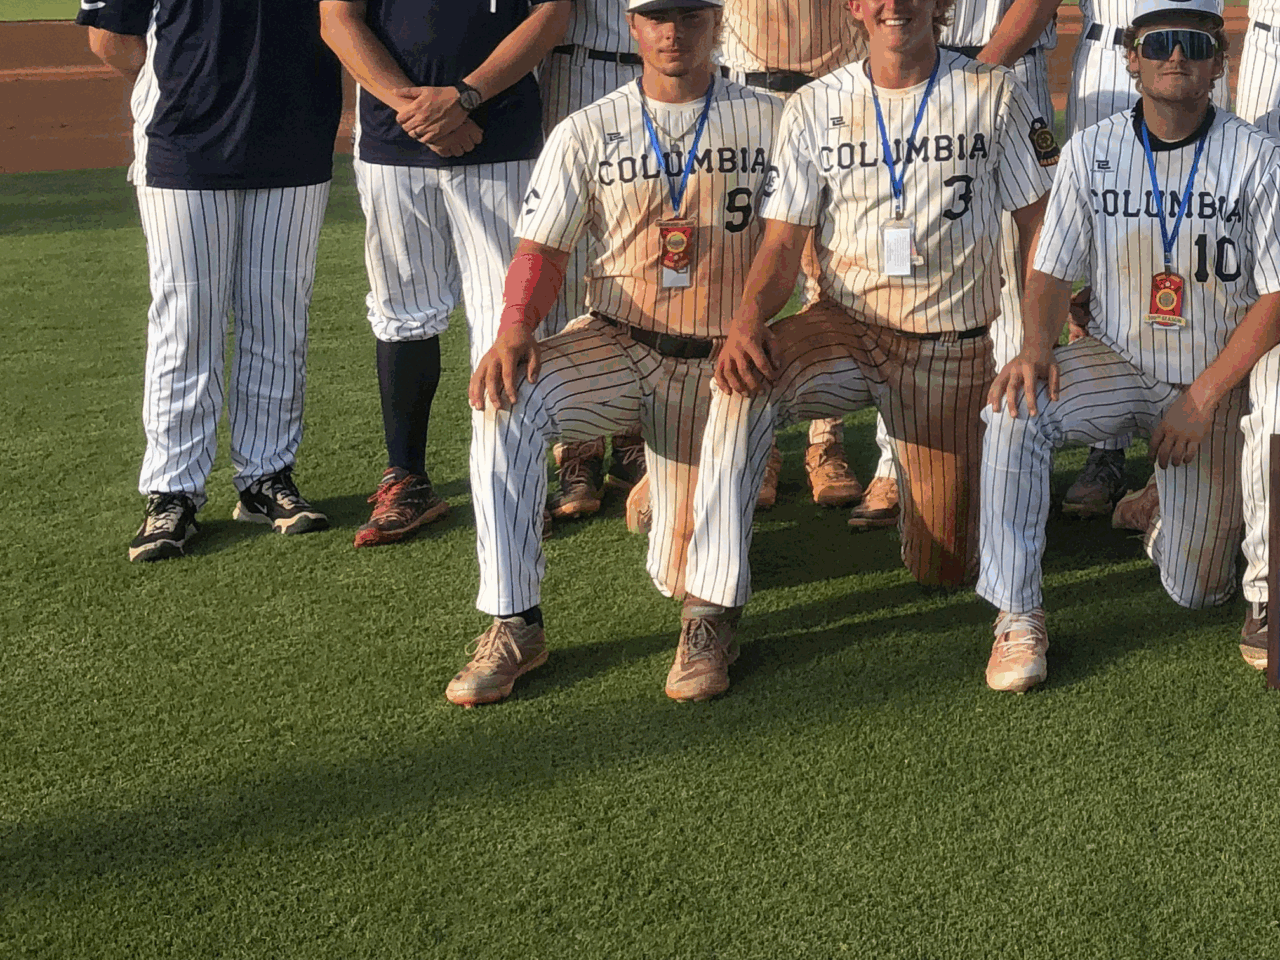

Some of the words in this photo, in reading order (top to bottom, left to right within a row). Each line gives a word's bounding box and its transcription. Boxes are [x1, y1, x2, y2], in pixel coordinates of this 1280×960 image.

[598, 146, 765, 187] COLUMBIA
[820, 133, 988, 173] COLUMBIA
[725, 187, 753, 234] 9
[943, 174, 974, 221] 3
[1194, 233, 1242, 283] 10
